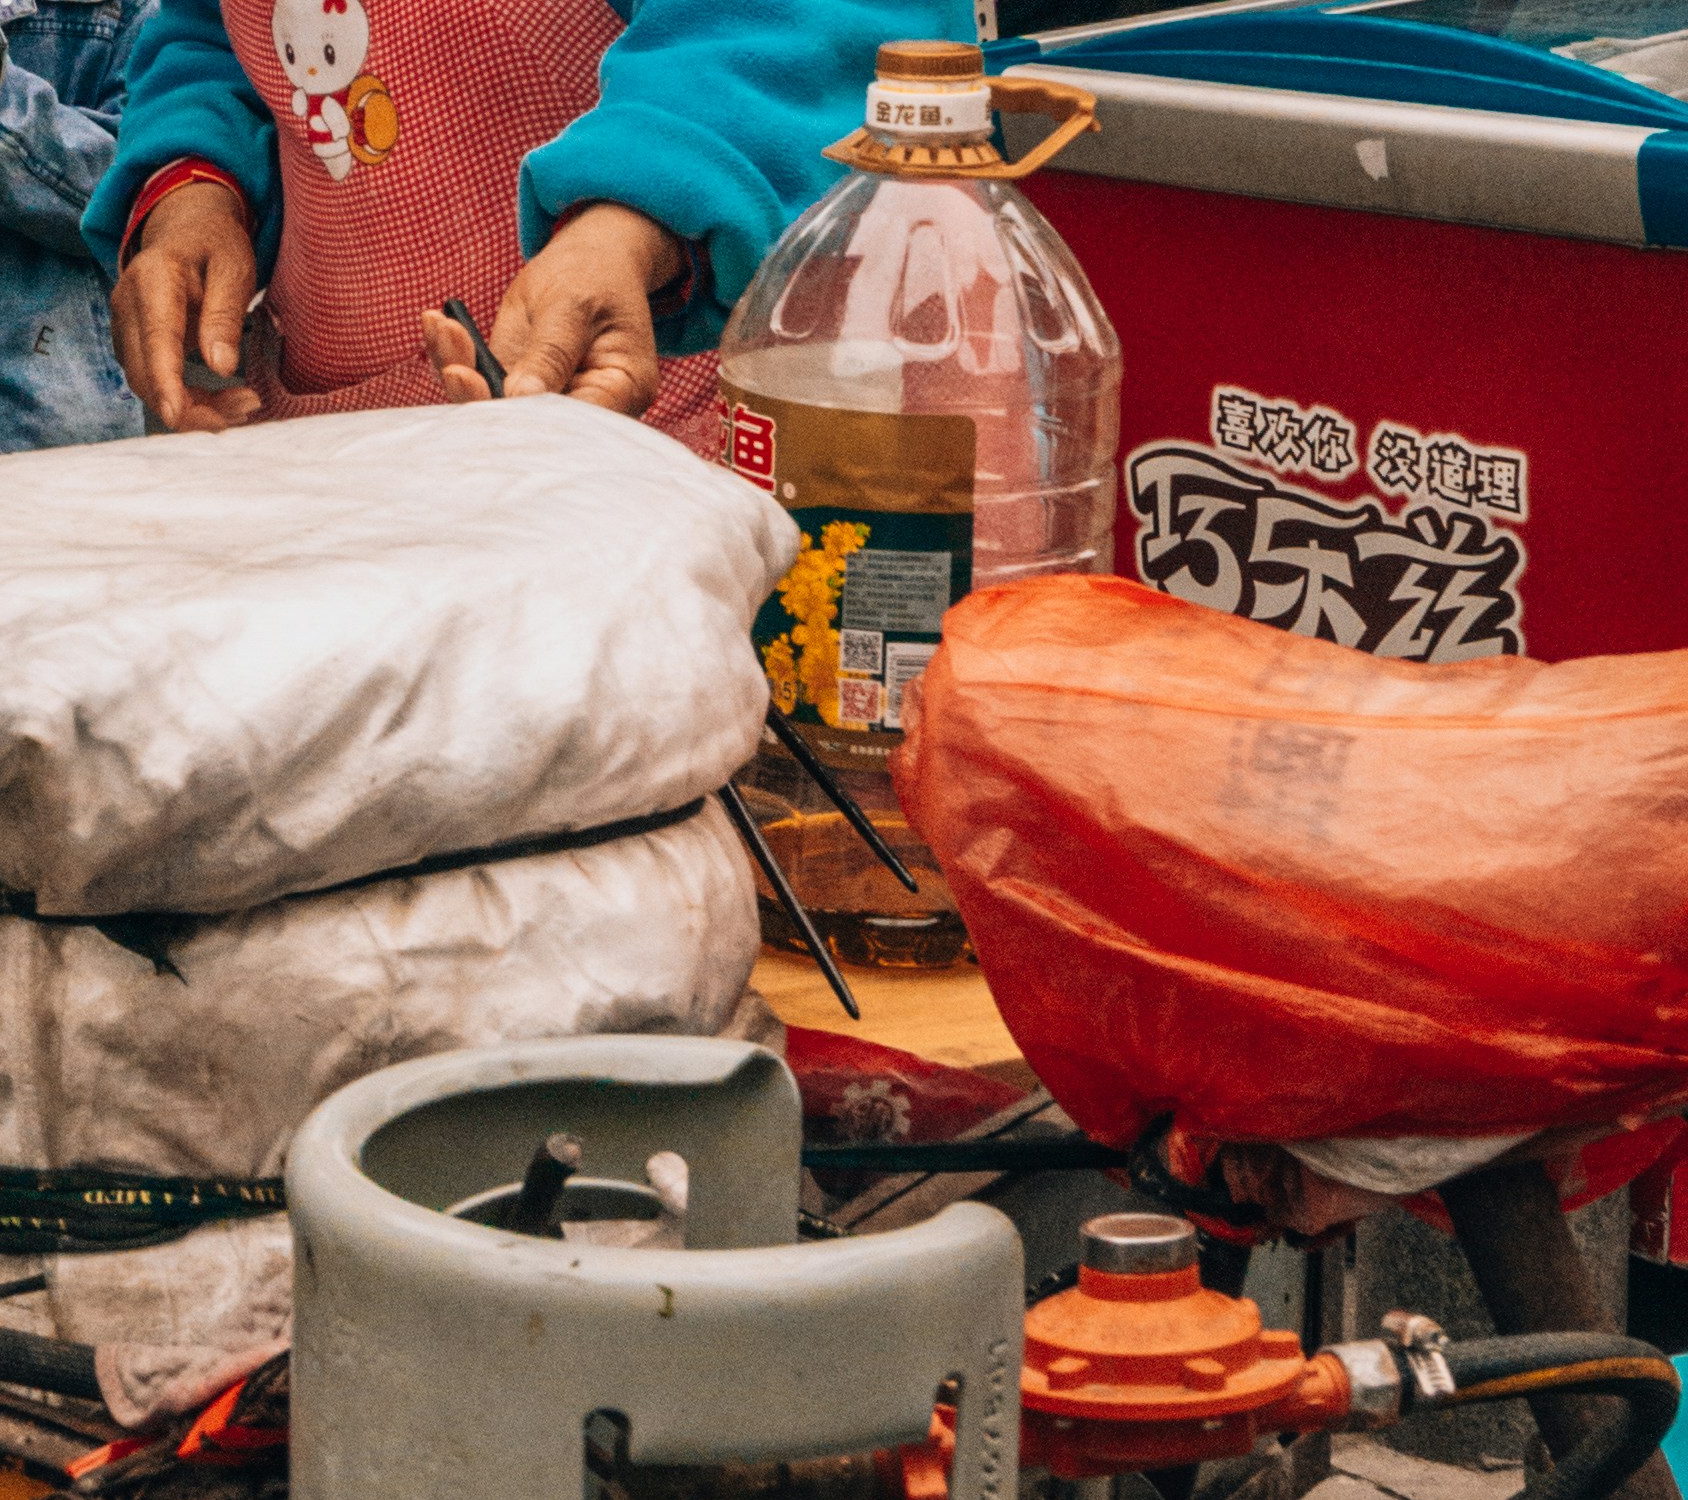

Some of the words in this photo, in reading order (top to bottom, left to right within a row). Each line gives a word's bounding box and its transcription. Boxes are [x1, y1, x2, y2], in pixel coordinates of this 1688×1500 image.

[876, 100, 942, 126] 金龙鱼
[1217, 394, 1354, 473] 喜欢你
[1373, 428, 1522, 514] 没道理
